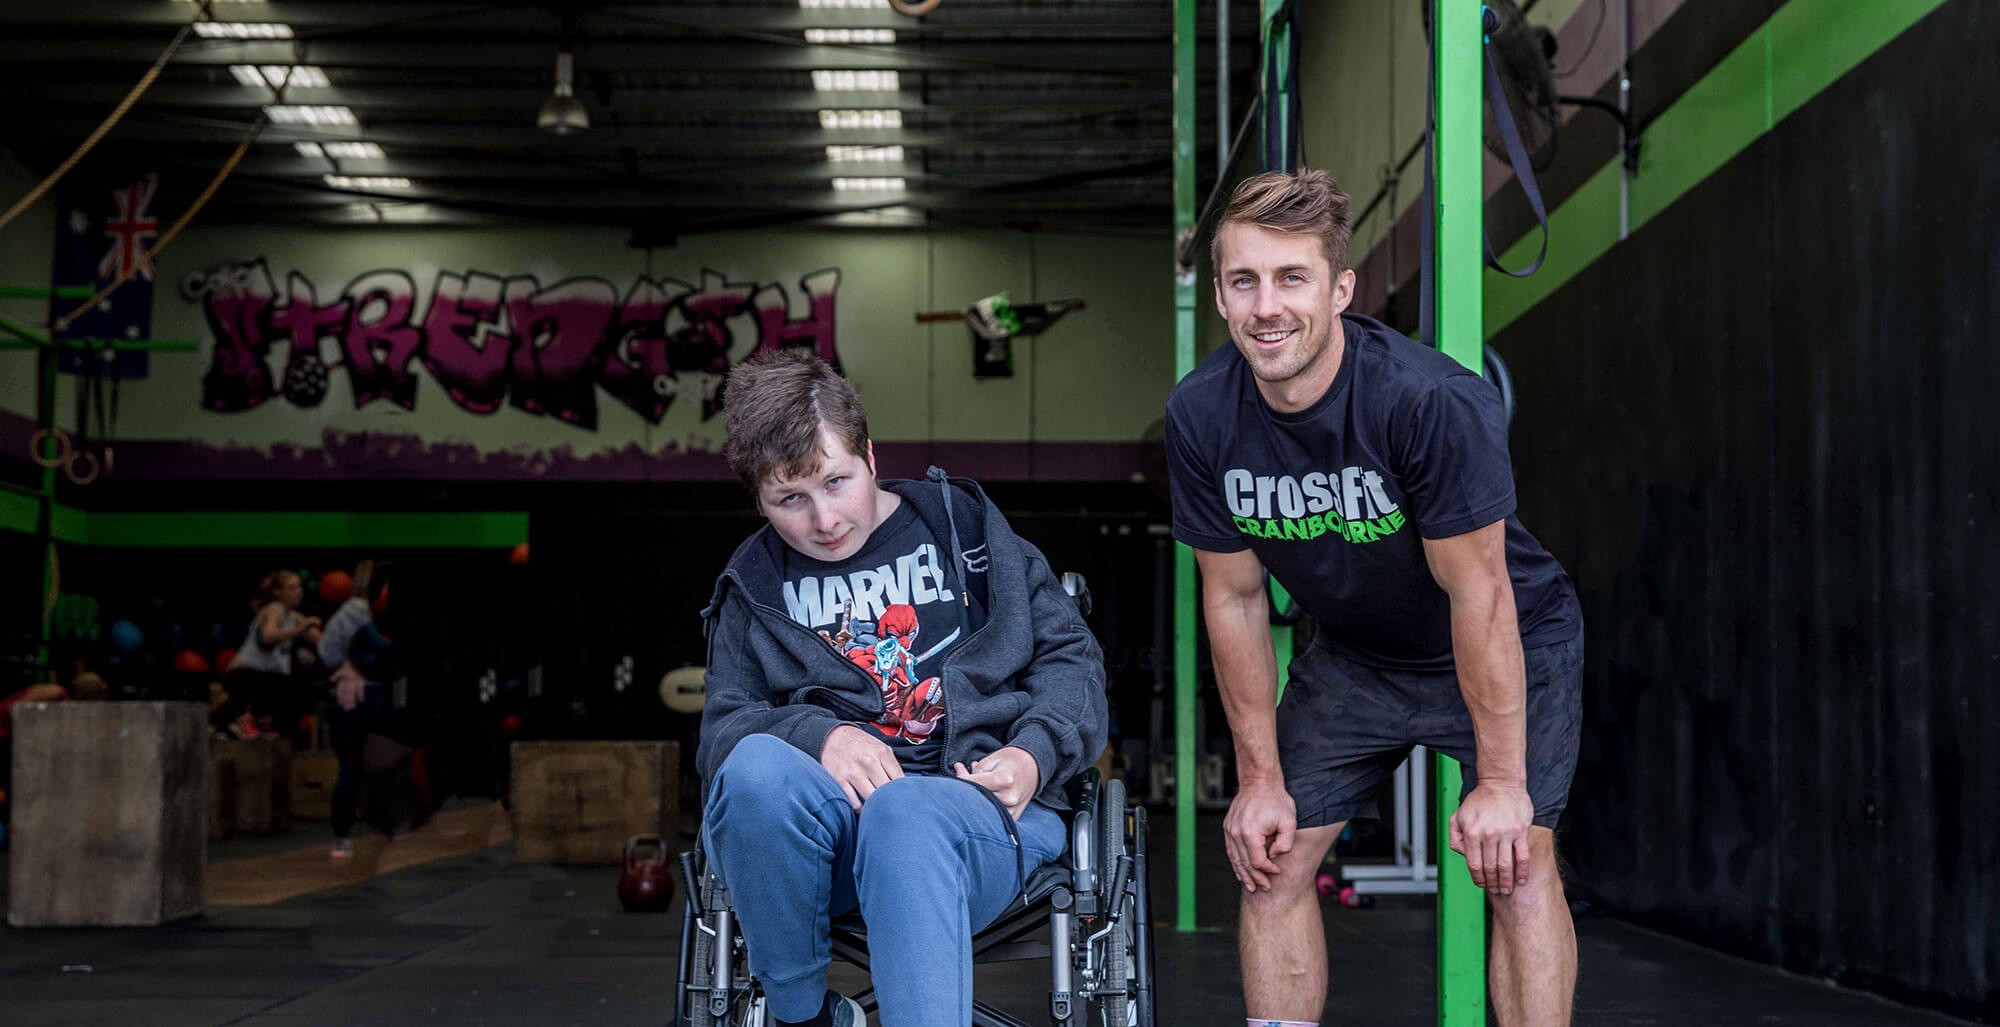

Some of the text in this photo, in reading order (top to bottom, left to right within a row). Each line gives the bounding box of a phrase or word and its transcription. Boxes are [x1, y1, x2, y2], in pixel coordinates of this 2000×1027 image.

[1224, 466, 1398, 520] CrossFit
[1232, 508, 1407, 543] CRANBOURNE
[783, 544, 955, 628] MARVEL
